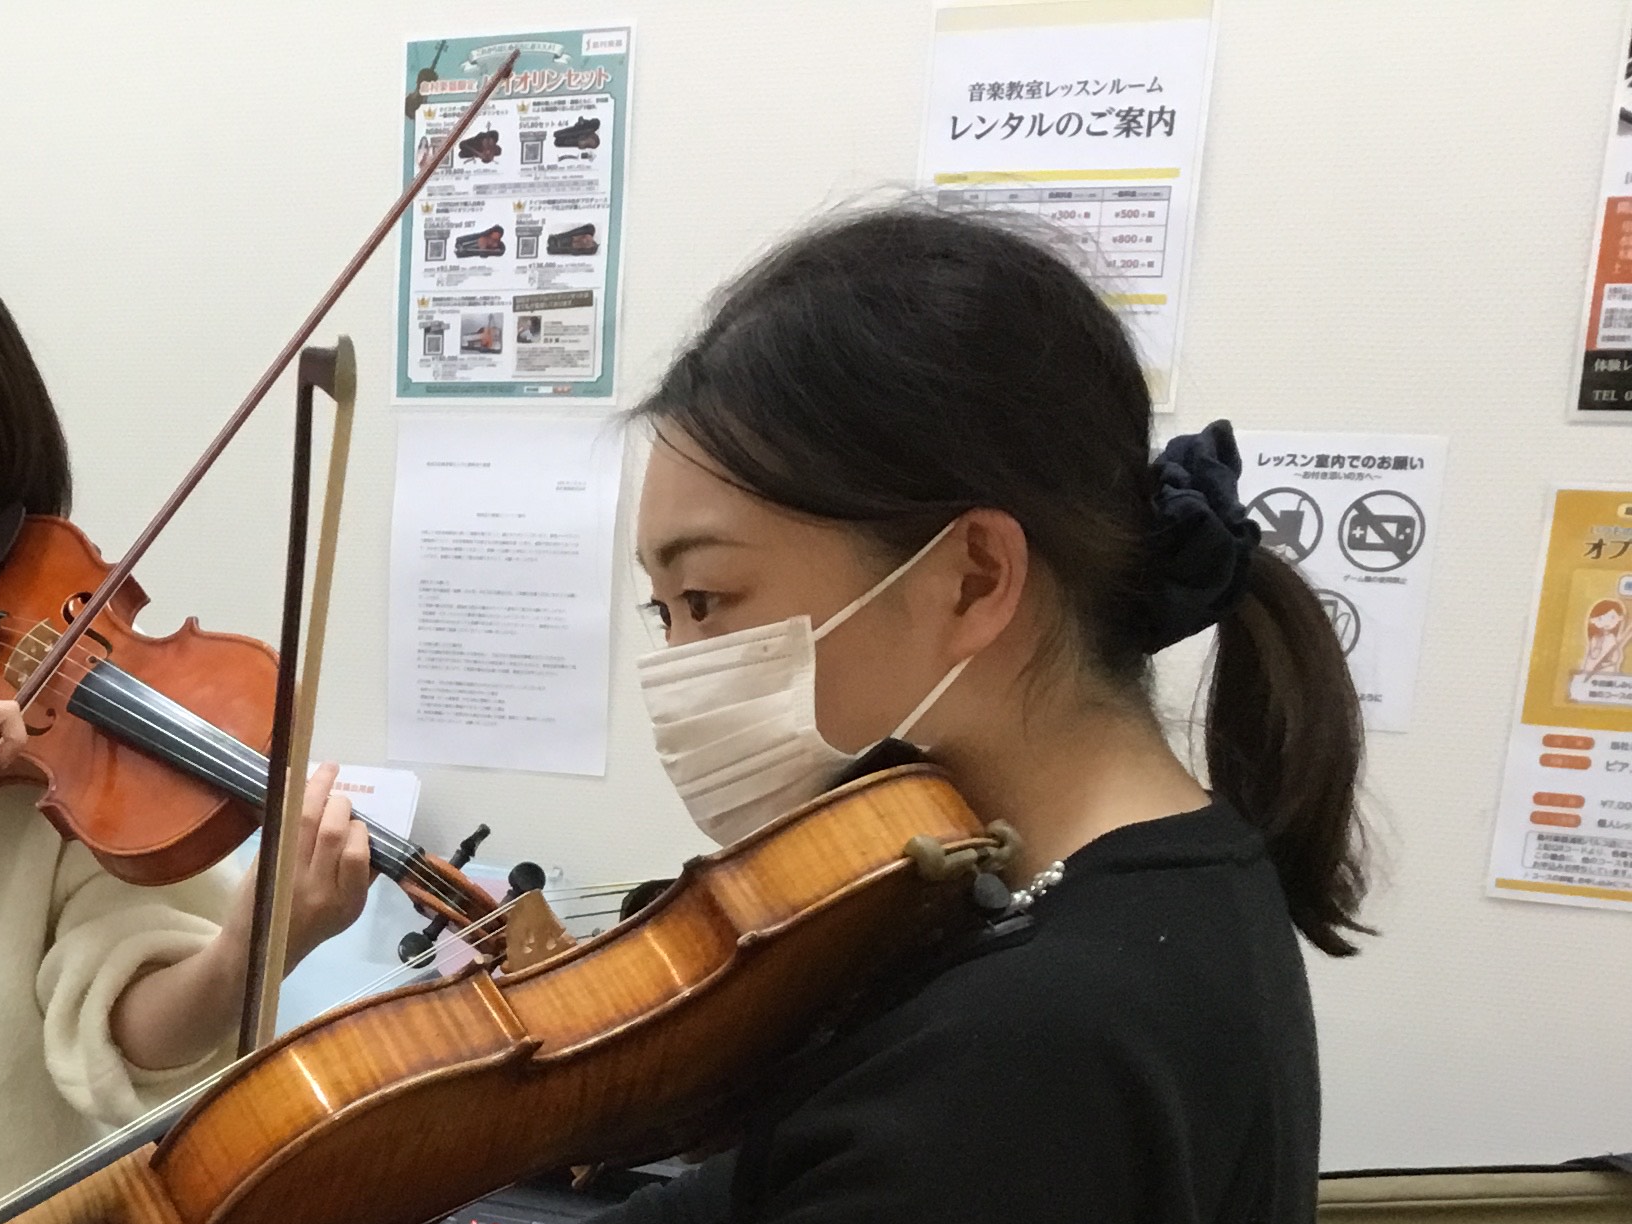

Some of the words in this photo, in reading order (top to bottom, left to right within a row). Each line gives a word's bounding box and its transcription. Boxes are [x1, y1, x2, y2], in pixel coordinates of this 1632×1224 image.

[968, 76, 1164, 102] 音楽教室レッスンルーム
[950, 105, 1176, 140] レンタルのご案内
[1592, 389, 1618, 402] TEL
[1257, 453, 1424, 471] レッスン室内でのお願い
